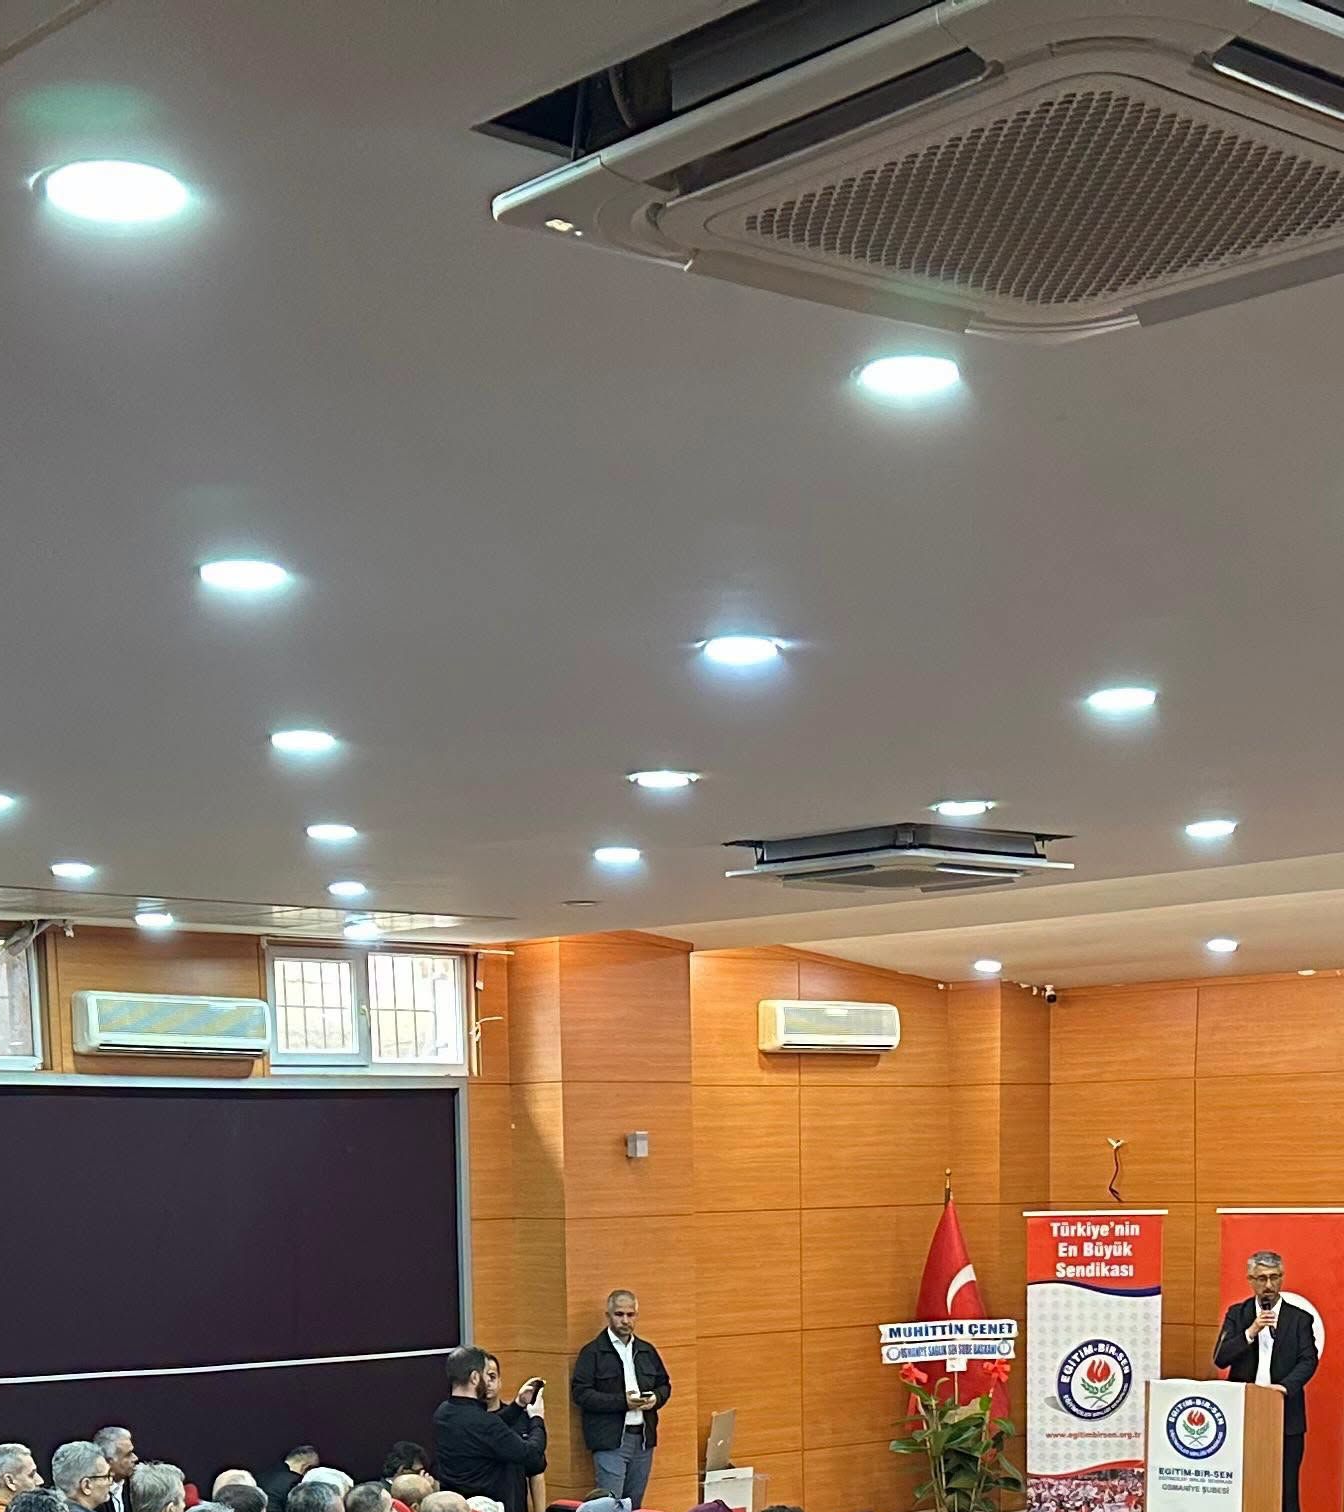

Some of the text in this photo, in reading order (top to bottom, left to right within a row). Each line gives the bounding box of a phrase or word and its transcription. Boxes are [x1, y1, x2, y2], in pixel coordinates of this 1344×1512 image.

[1050, 1221, 1141, 1240] Türkiye'nin
[1058, 1241, 1134, 1260] En Büyük
[1056, 1262, 1134, 1278] Sendikası
[889, 1323, 1015, 1338] MUHİTTİN ÇENET
